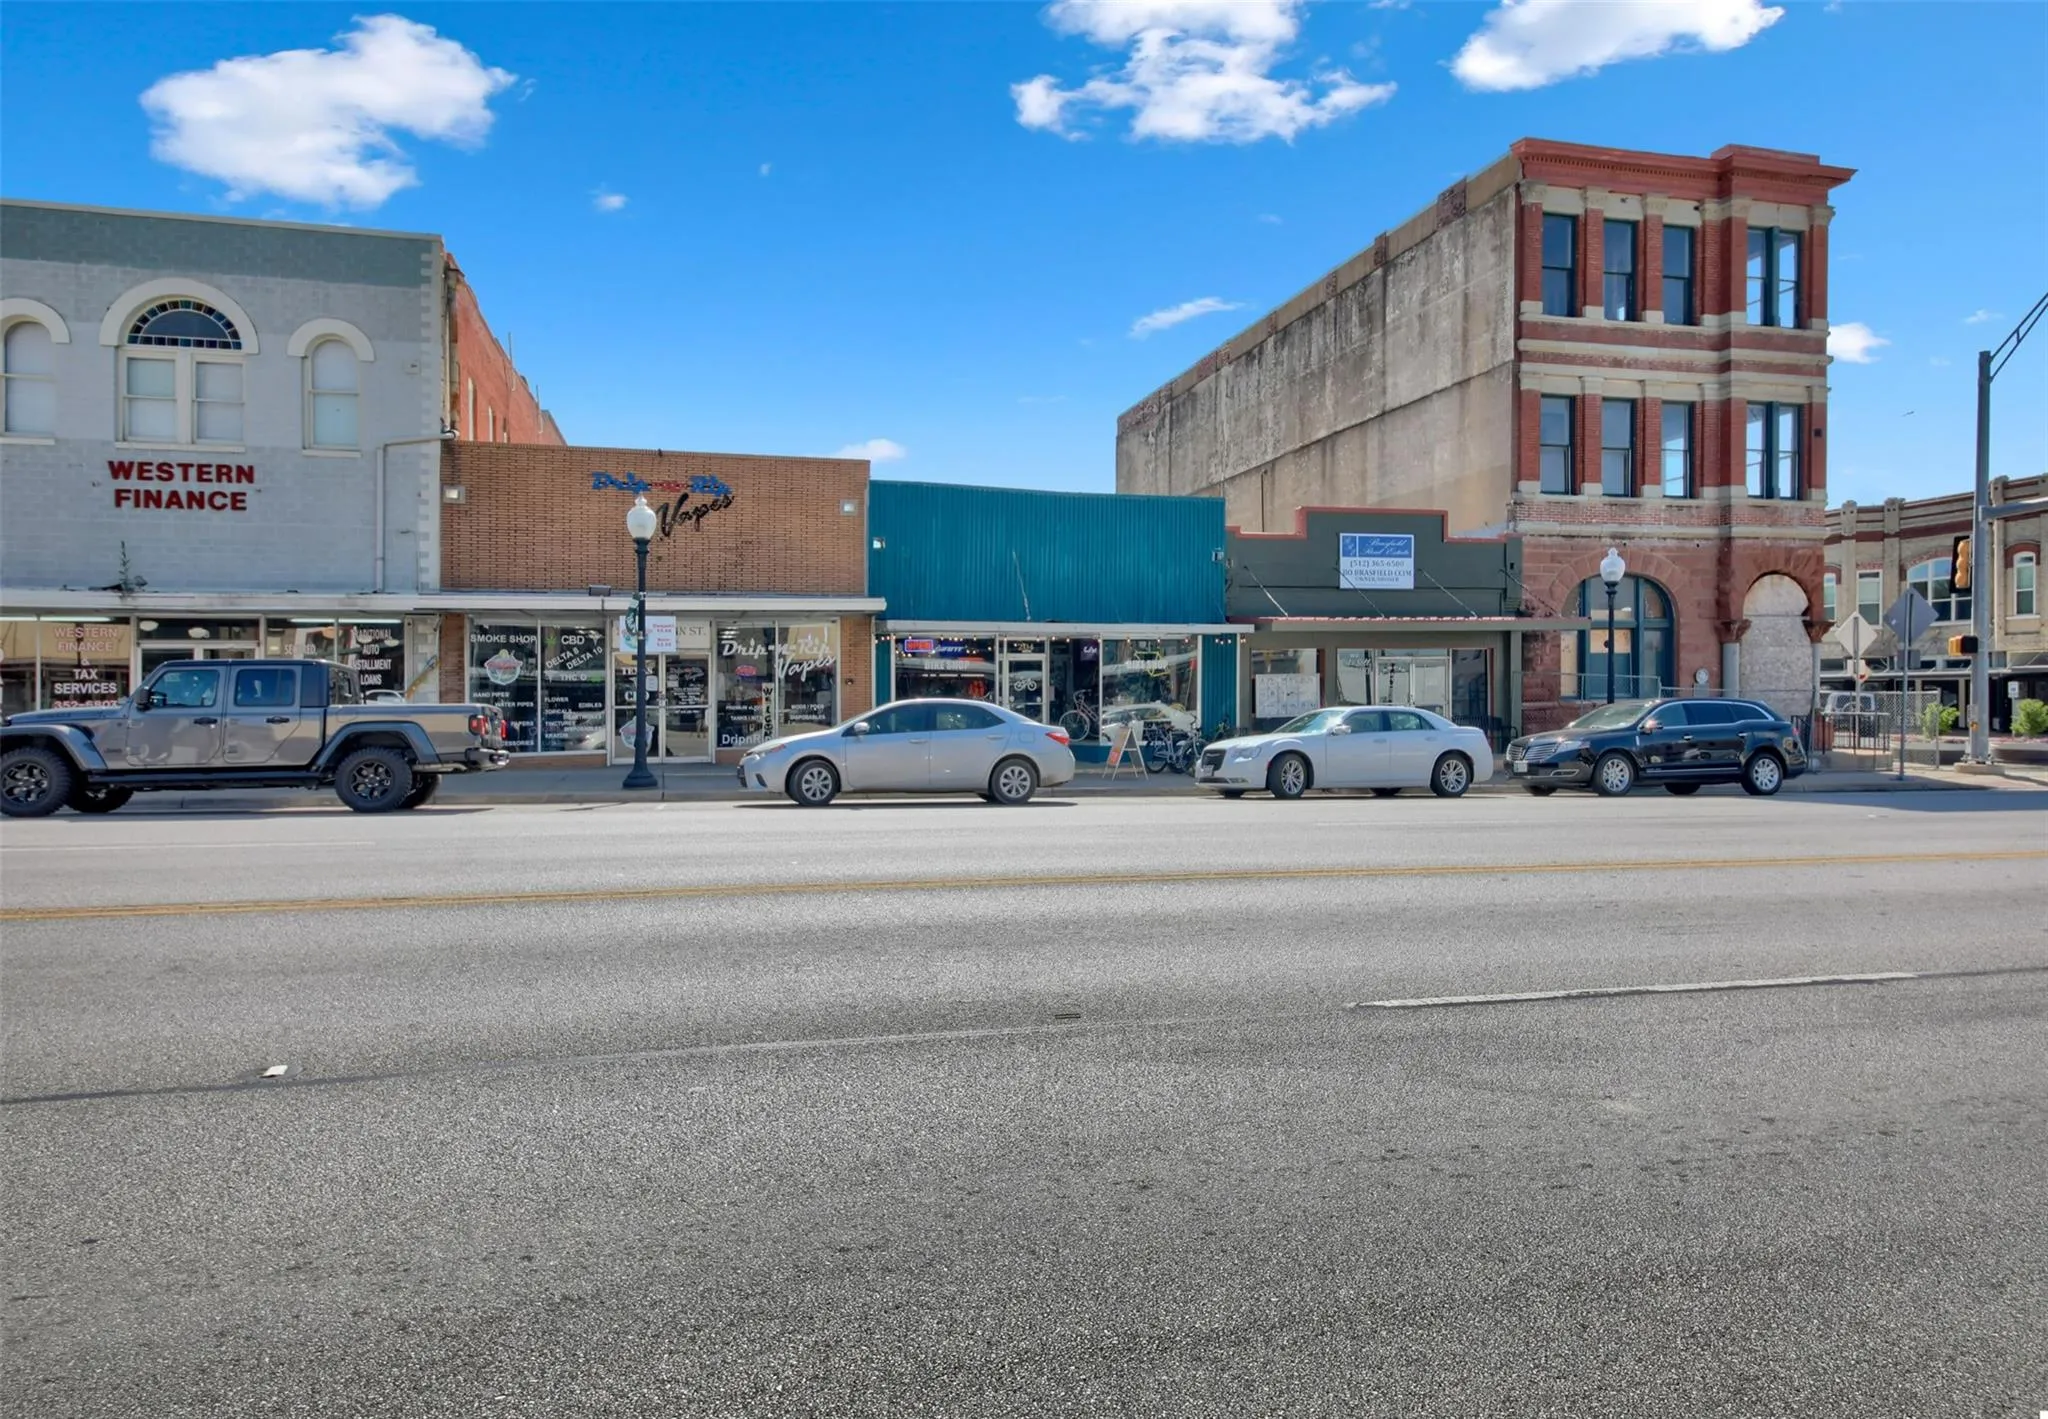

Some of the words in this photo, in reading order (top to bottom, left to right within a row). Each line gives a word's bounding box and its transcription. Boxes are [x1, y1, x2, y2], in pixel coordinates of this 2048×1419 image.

[108, 461, 254, 484] WESTERN
[114, 489, 247, 511] FINANCE
[656, 492, 735, 537] Vapes
[54, 627, 118, 639] WESTERN
[470, 634, 507, 643] SMOKE
[510, 635, 537, 644] SHOP
[58, 641, 113, 651] FINANCE
[561, 635, 585, 645] CBD
[362, 644, 380, 656] AUTO
[546, 651, 574, 668] DELTA
[566, 652, 593, 669] DELTA
[593, 646, 603, 656] 10
[73, 669, 98, 680] TAX
[776, 655, 836, 682] Vapes
[361, 674, 382, 685] LOANS
[54, 683, 117, 694] SERVICES
